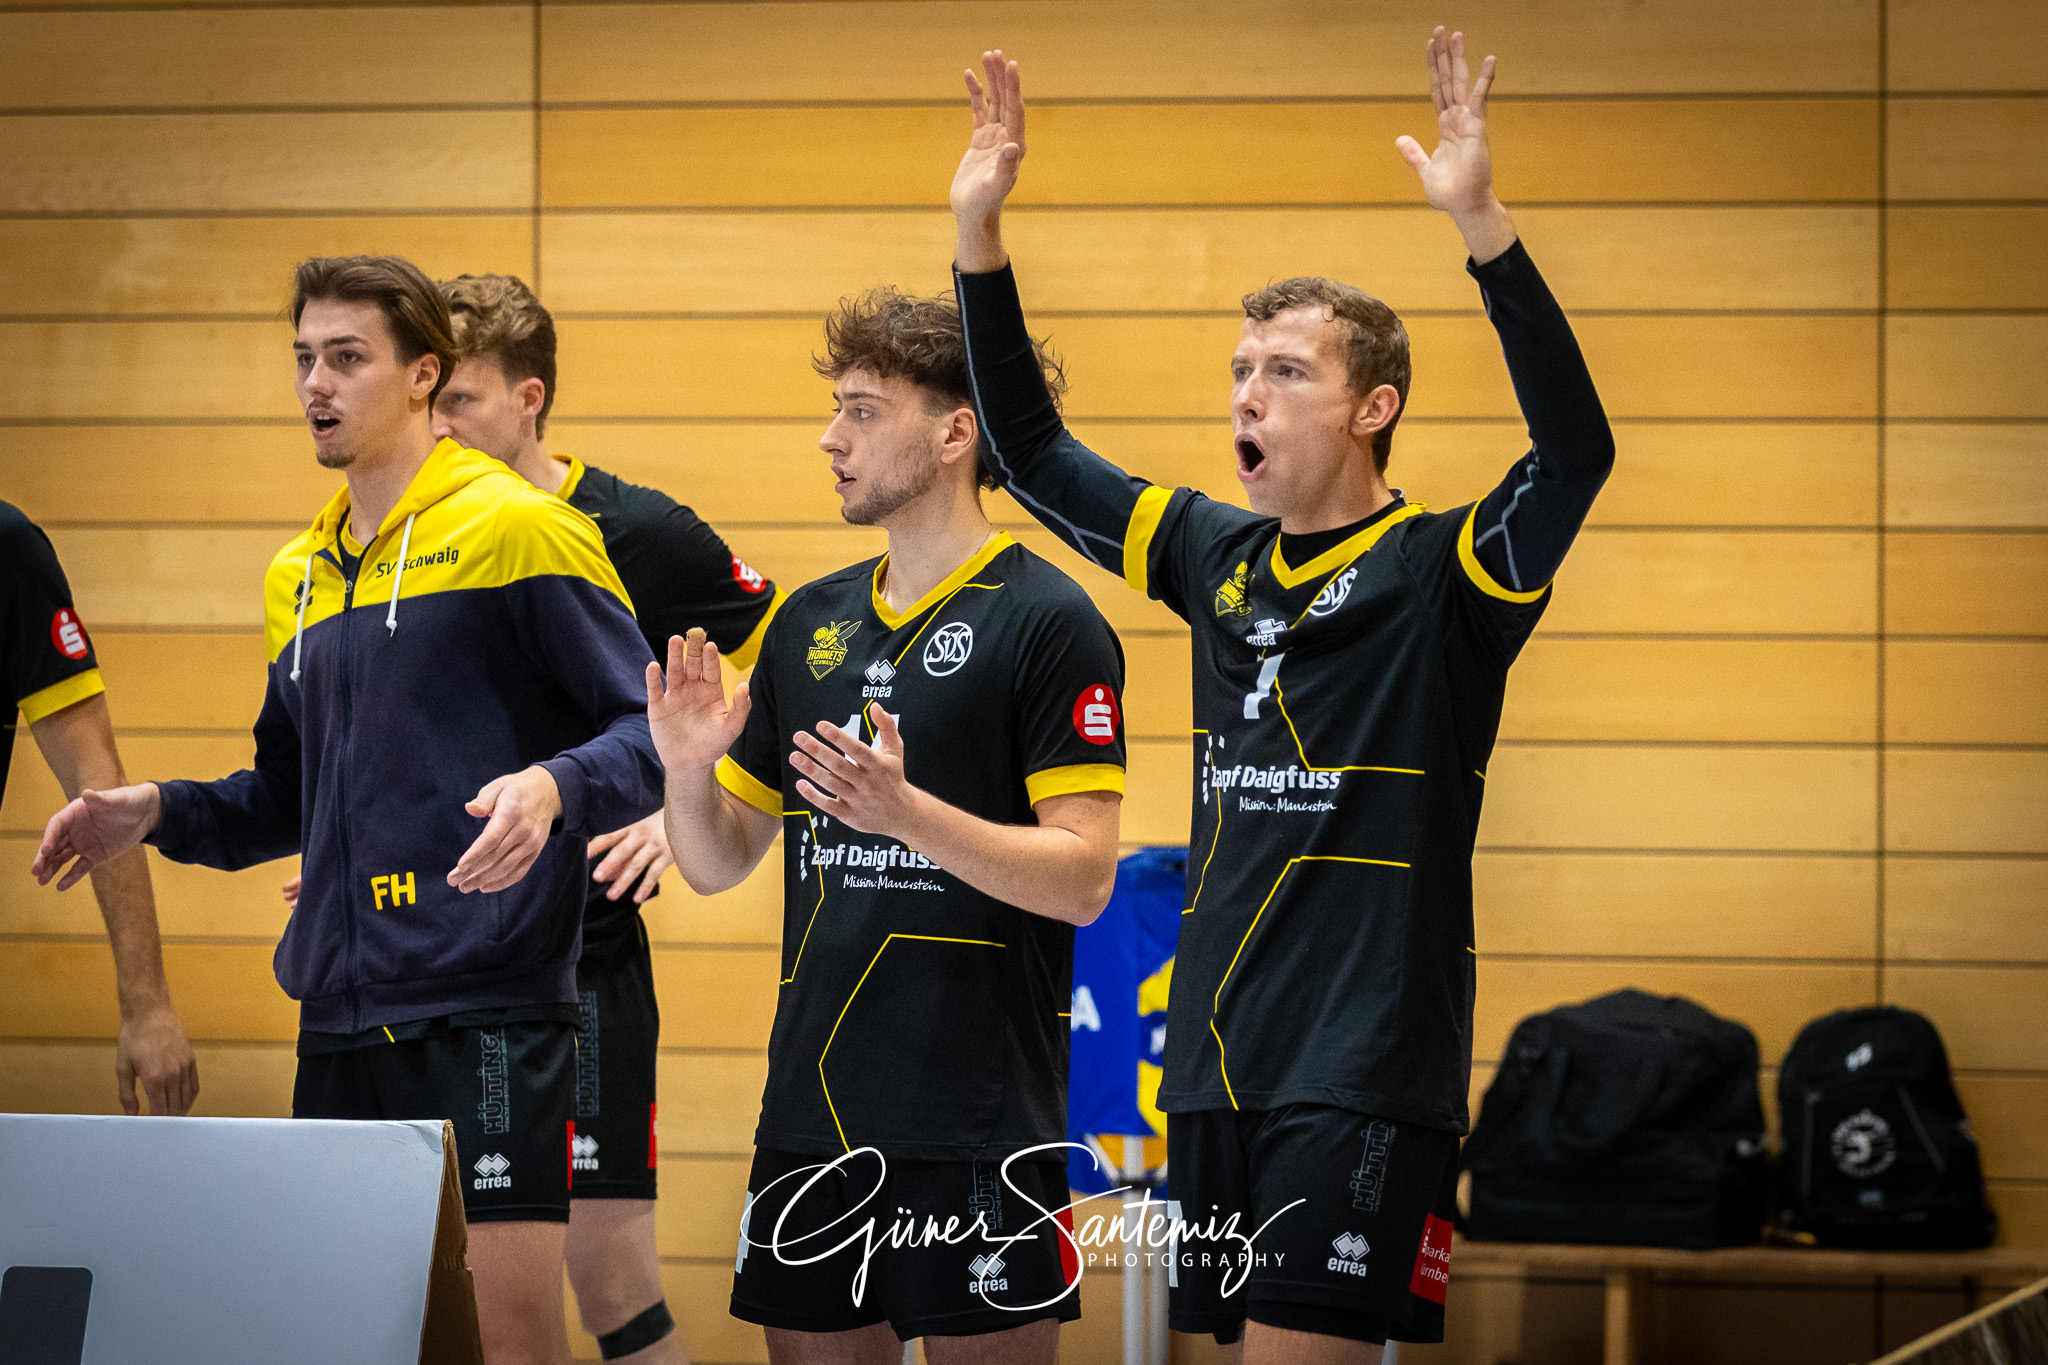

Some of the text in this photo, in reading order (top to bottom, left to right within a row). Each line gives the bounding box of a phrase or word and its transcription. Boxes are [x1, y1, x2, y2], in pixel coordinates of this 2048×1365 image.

[376, 546, 459, 578] SV Schwaig
[1246, 632, 1277, 647] errea
[808, 649, 845, 663] HORNETS
[861, 685, 893, 698] errea
[1211, 764, 1342, 794] Zapf Daigfuss
[811, 844, 846, 869] Zapf
[371, 871, 416, 911] FH
[571, 1157, 599, 1171] rrea
[474, 1175, 512, 1190] errea
[1327, 1257, 1367, 1277] errea
